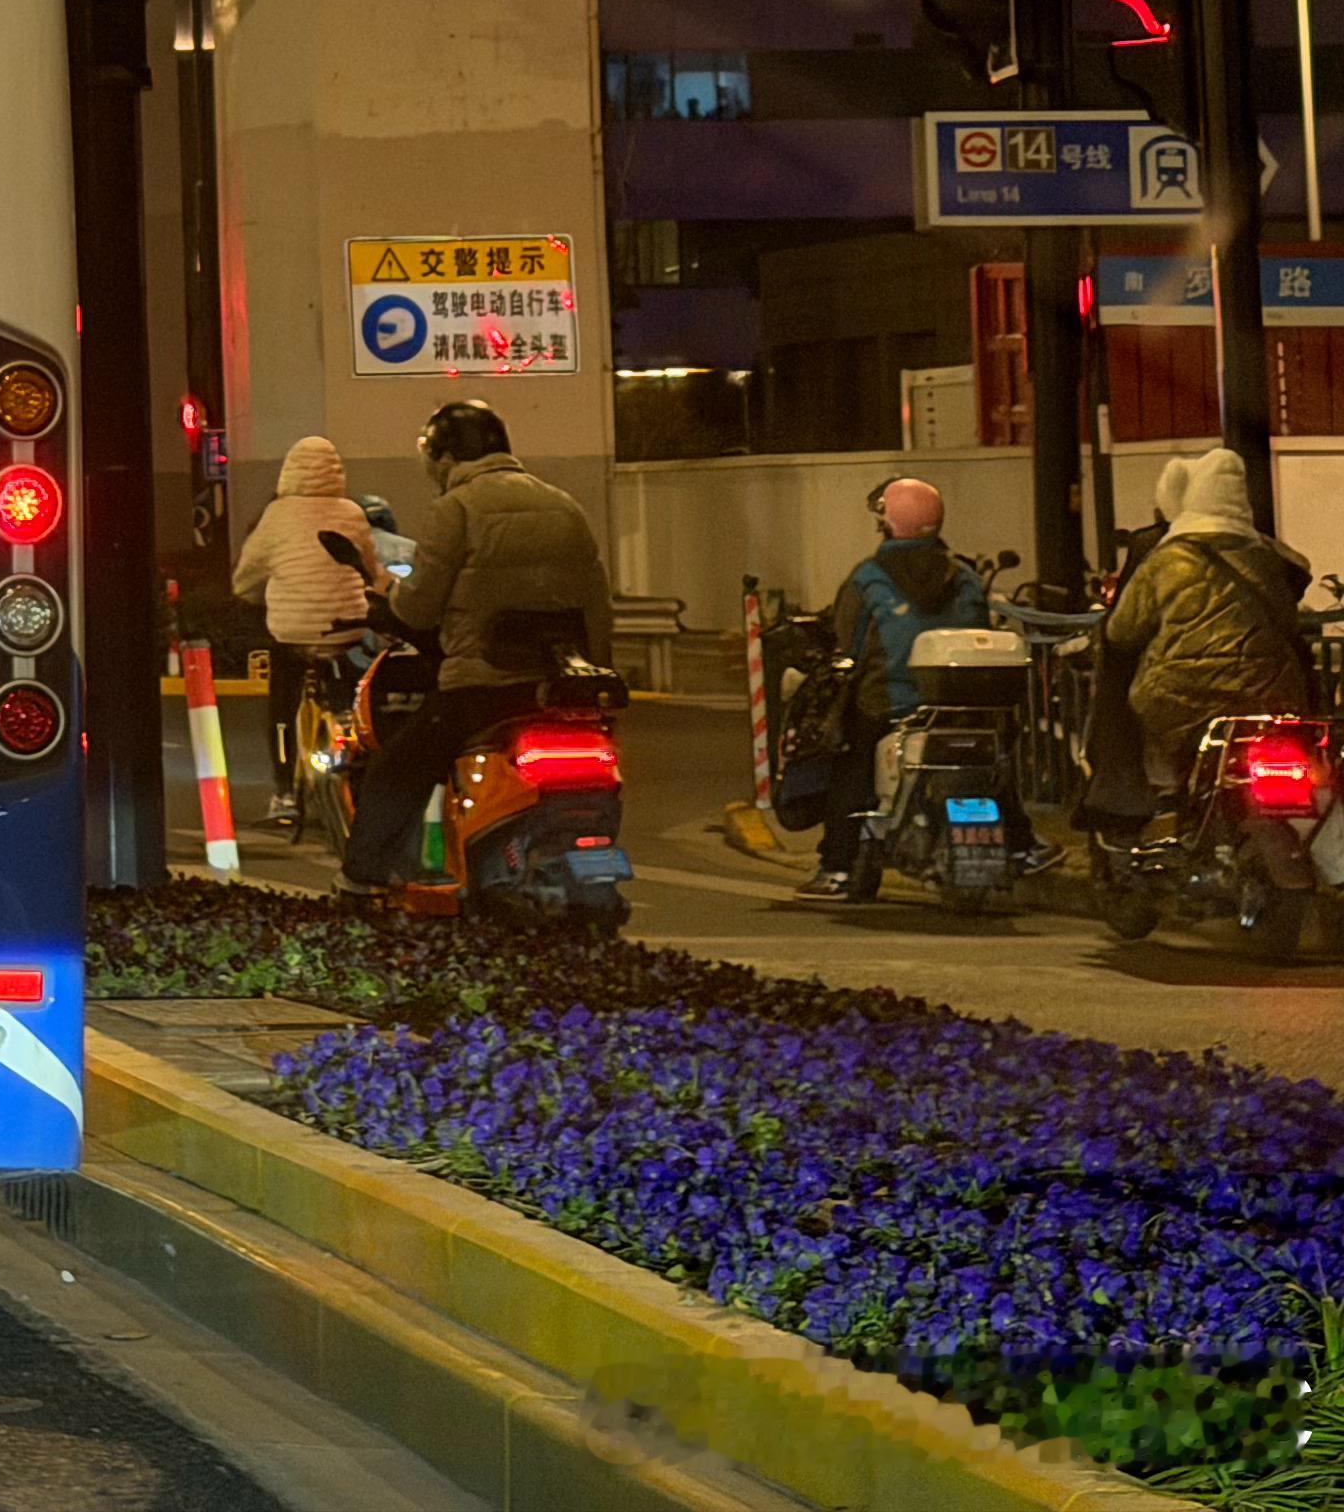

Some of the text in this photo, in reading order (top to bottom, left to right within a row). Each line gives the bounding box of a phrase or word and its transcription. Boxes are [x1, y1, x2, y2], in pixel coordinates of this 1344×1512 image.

[420, 245, 546, 278] 交警提示
[431, 289, 564, 319] 驾驶电动自行车
